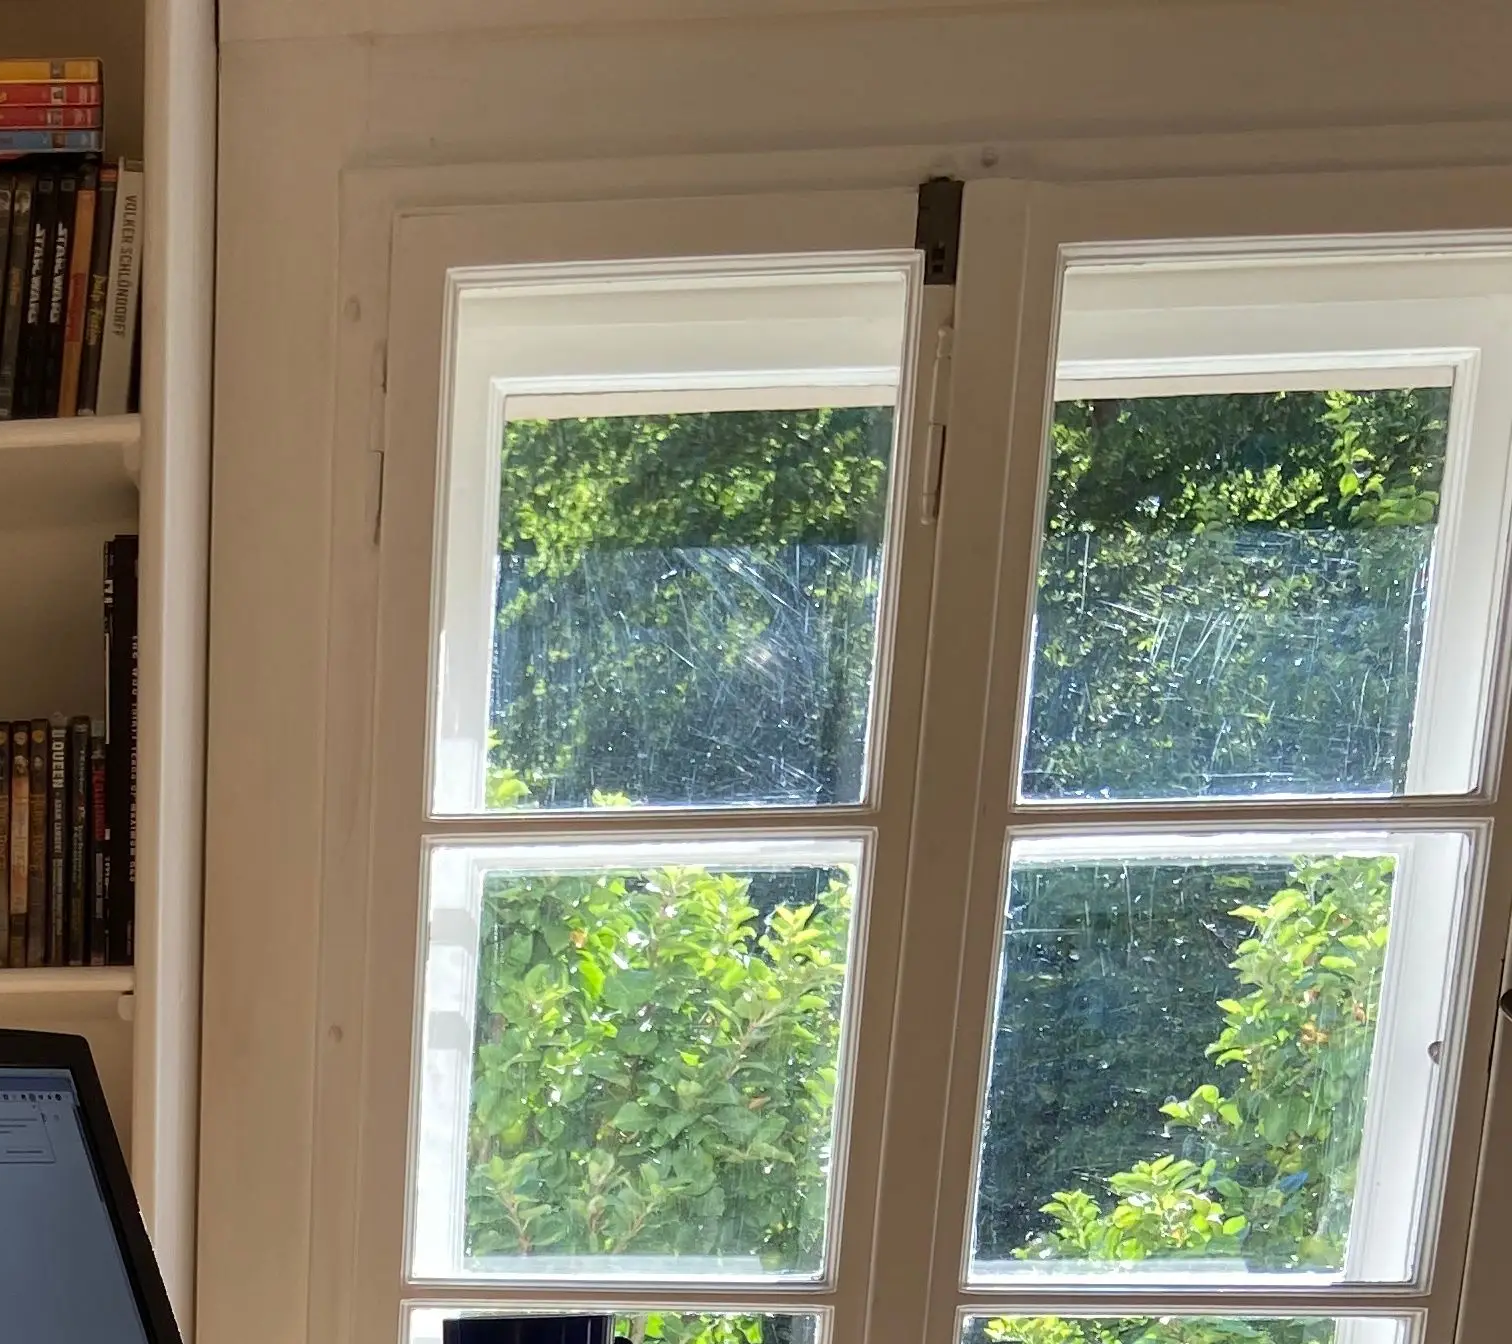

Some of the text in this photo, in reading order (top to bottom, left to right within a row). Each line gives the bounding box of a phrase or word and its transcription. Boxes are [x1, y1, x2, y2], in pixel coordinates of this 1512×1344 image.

[112, 195, 138, 338] VOLKER SCHLÖNDORFF
[52, 741, 64, 788] QUEEN
